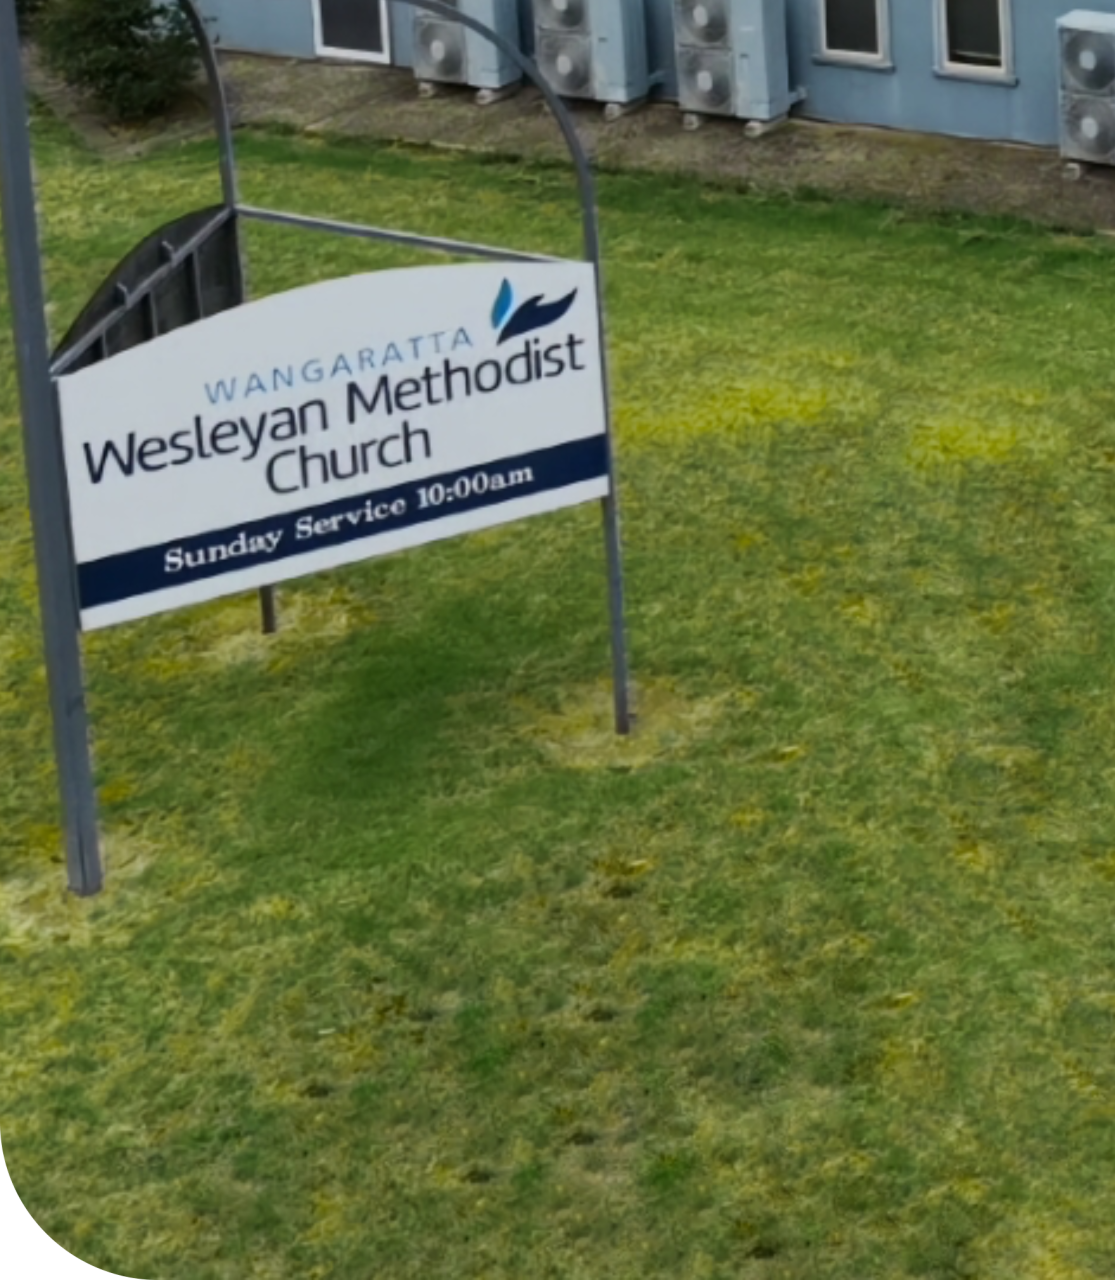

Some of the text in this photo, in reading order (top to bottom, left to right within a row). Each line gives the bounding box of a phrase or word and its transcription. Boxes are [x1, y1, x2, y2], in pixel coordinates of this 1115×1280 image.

[82, 332, 587, 484] Wesleyan Methodist
[204, 326, 473, 405] WANGARATTA
[265, 420, 432, 494] Church
[163, 463, 535, 573] Sunday Service 10:00am
